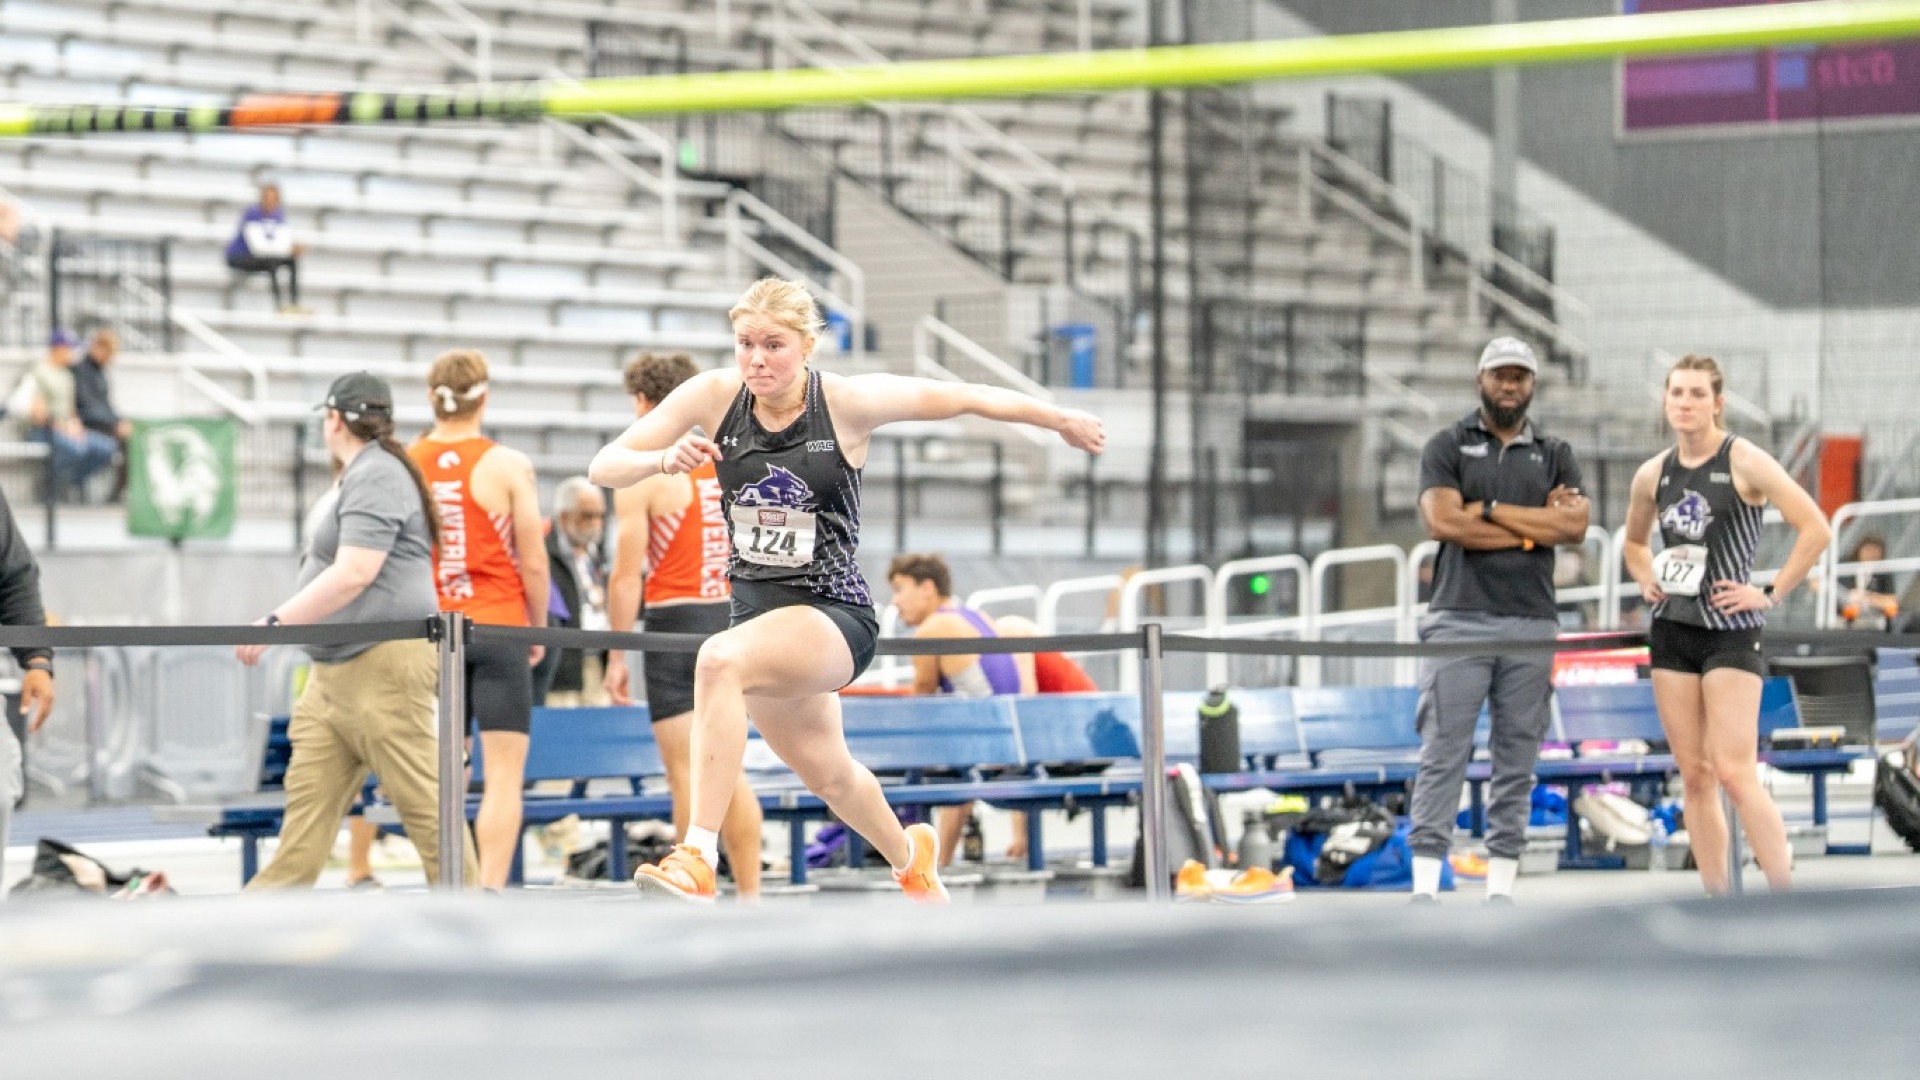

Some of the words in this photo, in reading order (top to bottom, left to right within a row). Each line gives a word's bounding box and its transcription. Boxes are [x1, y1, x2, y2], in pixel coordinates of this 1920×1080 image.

[805, 439, 834, 453] WAC
[1663, 508, 1703, 536] ACU
[748, 526, 797, 557] 124
[1661, 561, 1694, 583] 127
